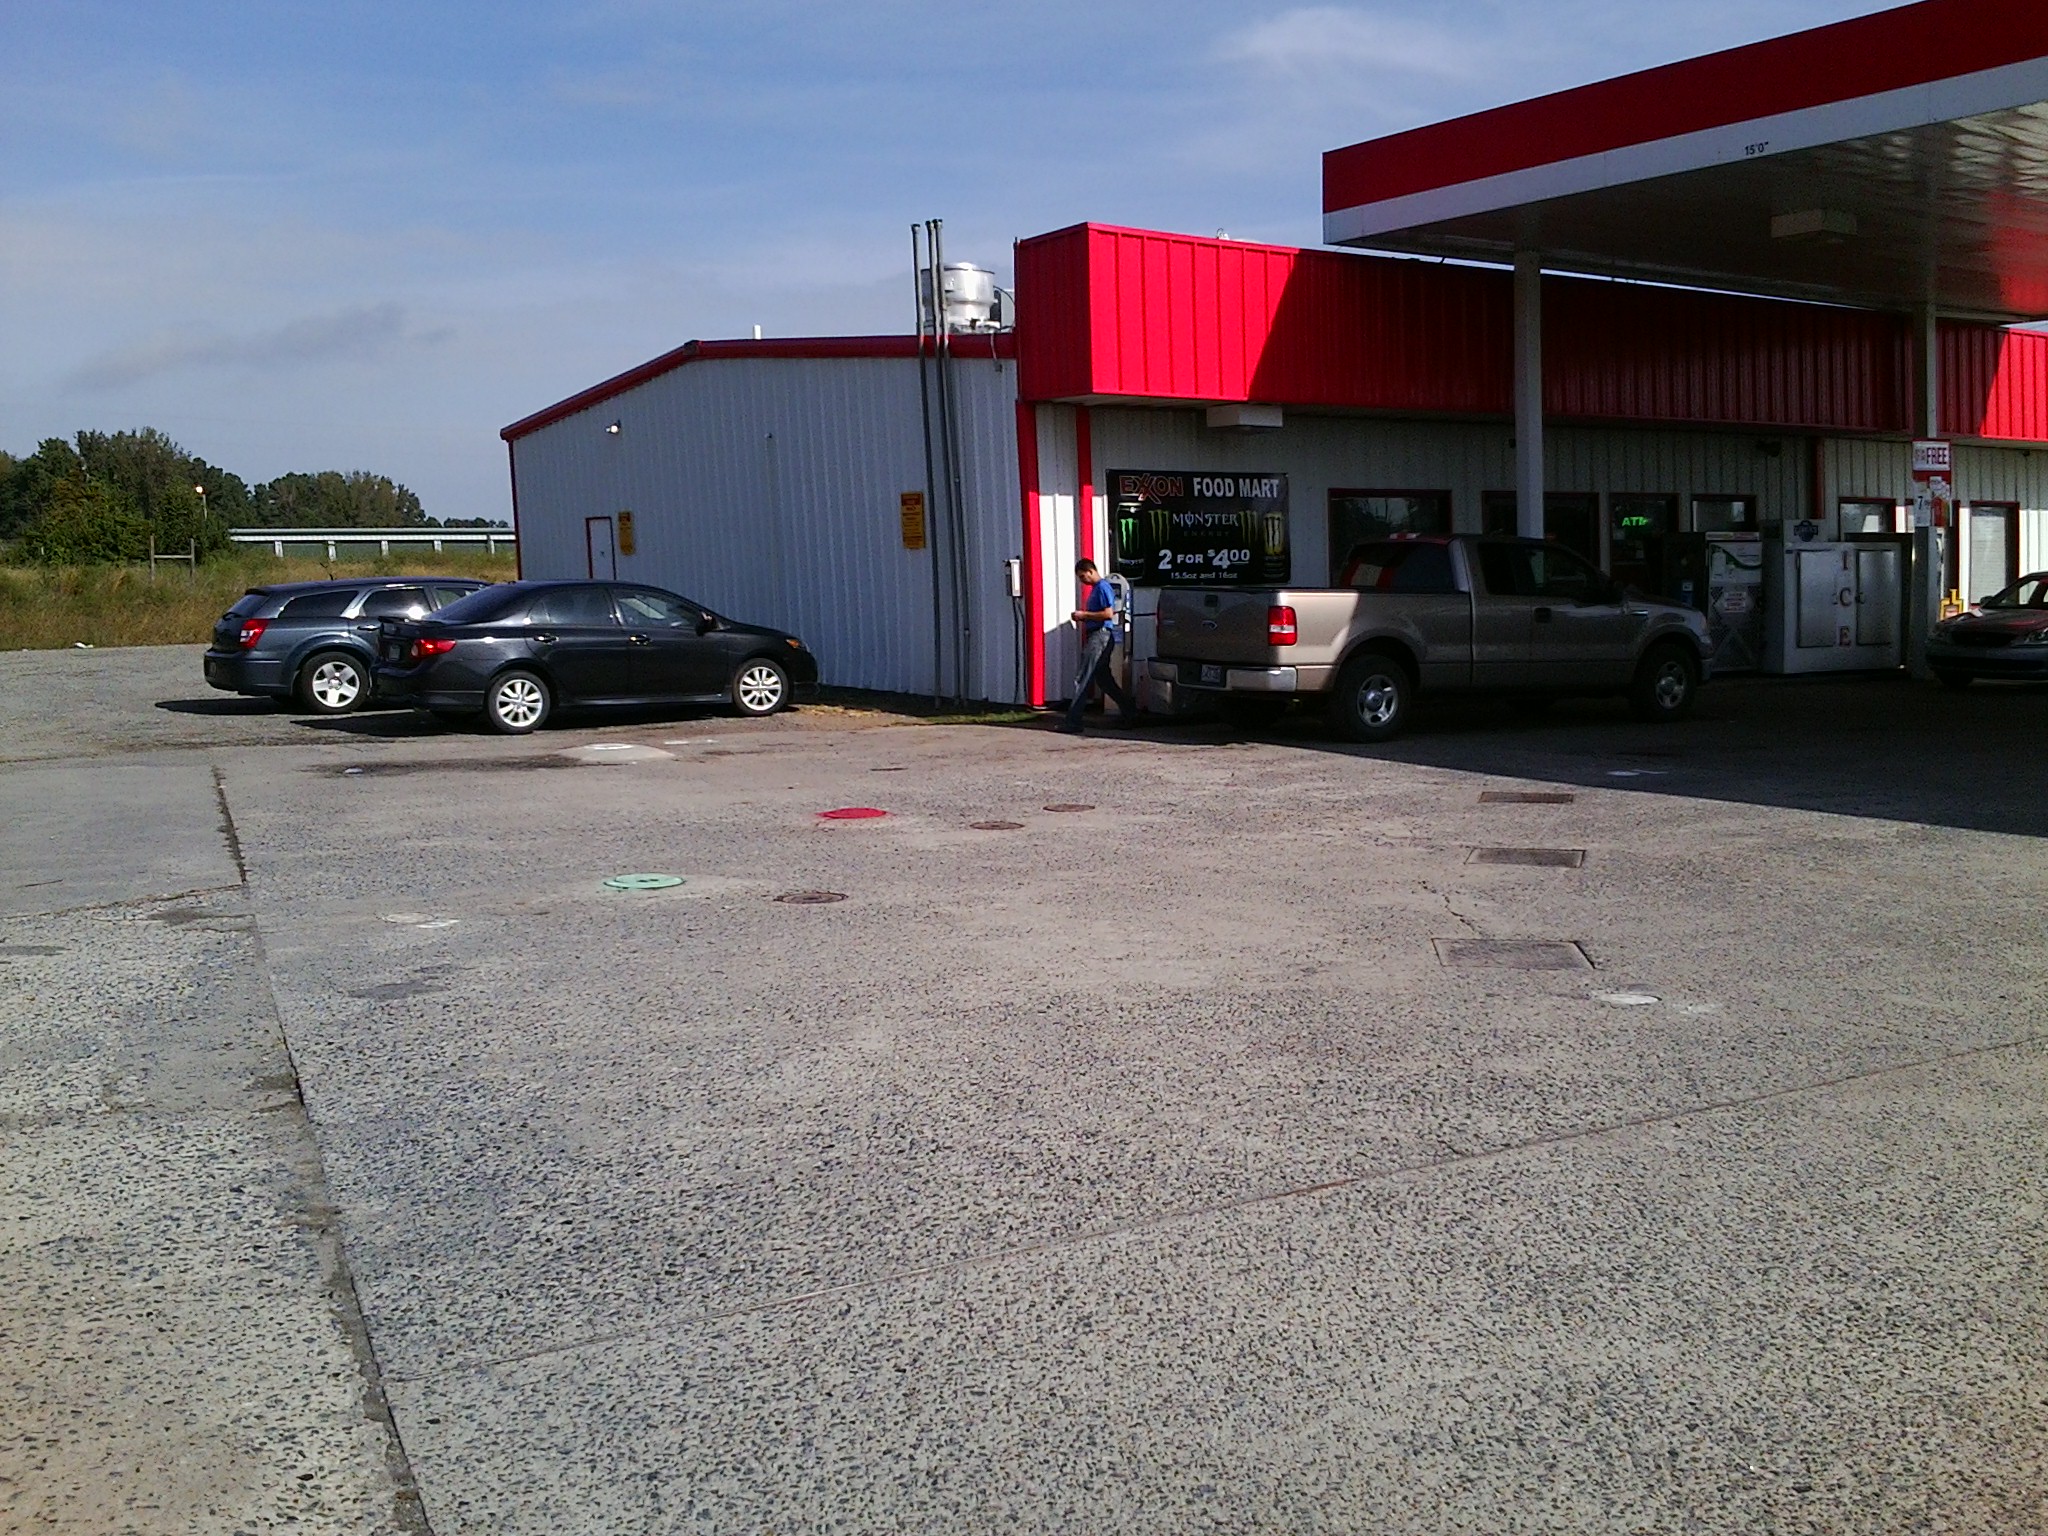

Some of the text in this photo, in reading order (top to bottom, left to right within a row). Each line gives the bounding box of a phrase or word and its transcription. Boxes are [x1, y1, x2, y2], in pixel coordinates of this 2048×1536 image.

[1926, 447, 1948, 465] FREE
[1118, 473, 1280, 505] EXXON FOOD MART
[1172, 511, 1240, 528] MONSTER
[1157, 549, 1173, 570] 2
[1177, 554, 1204, 565] FOR
[1199, 572, 1216, 580] and
